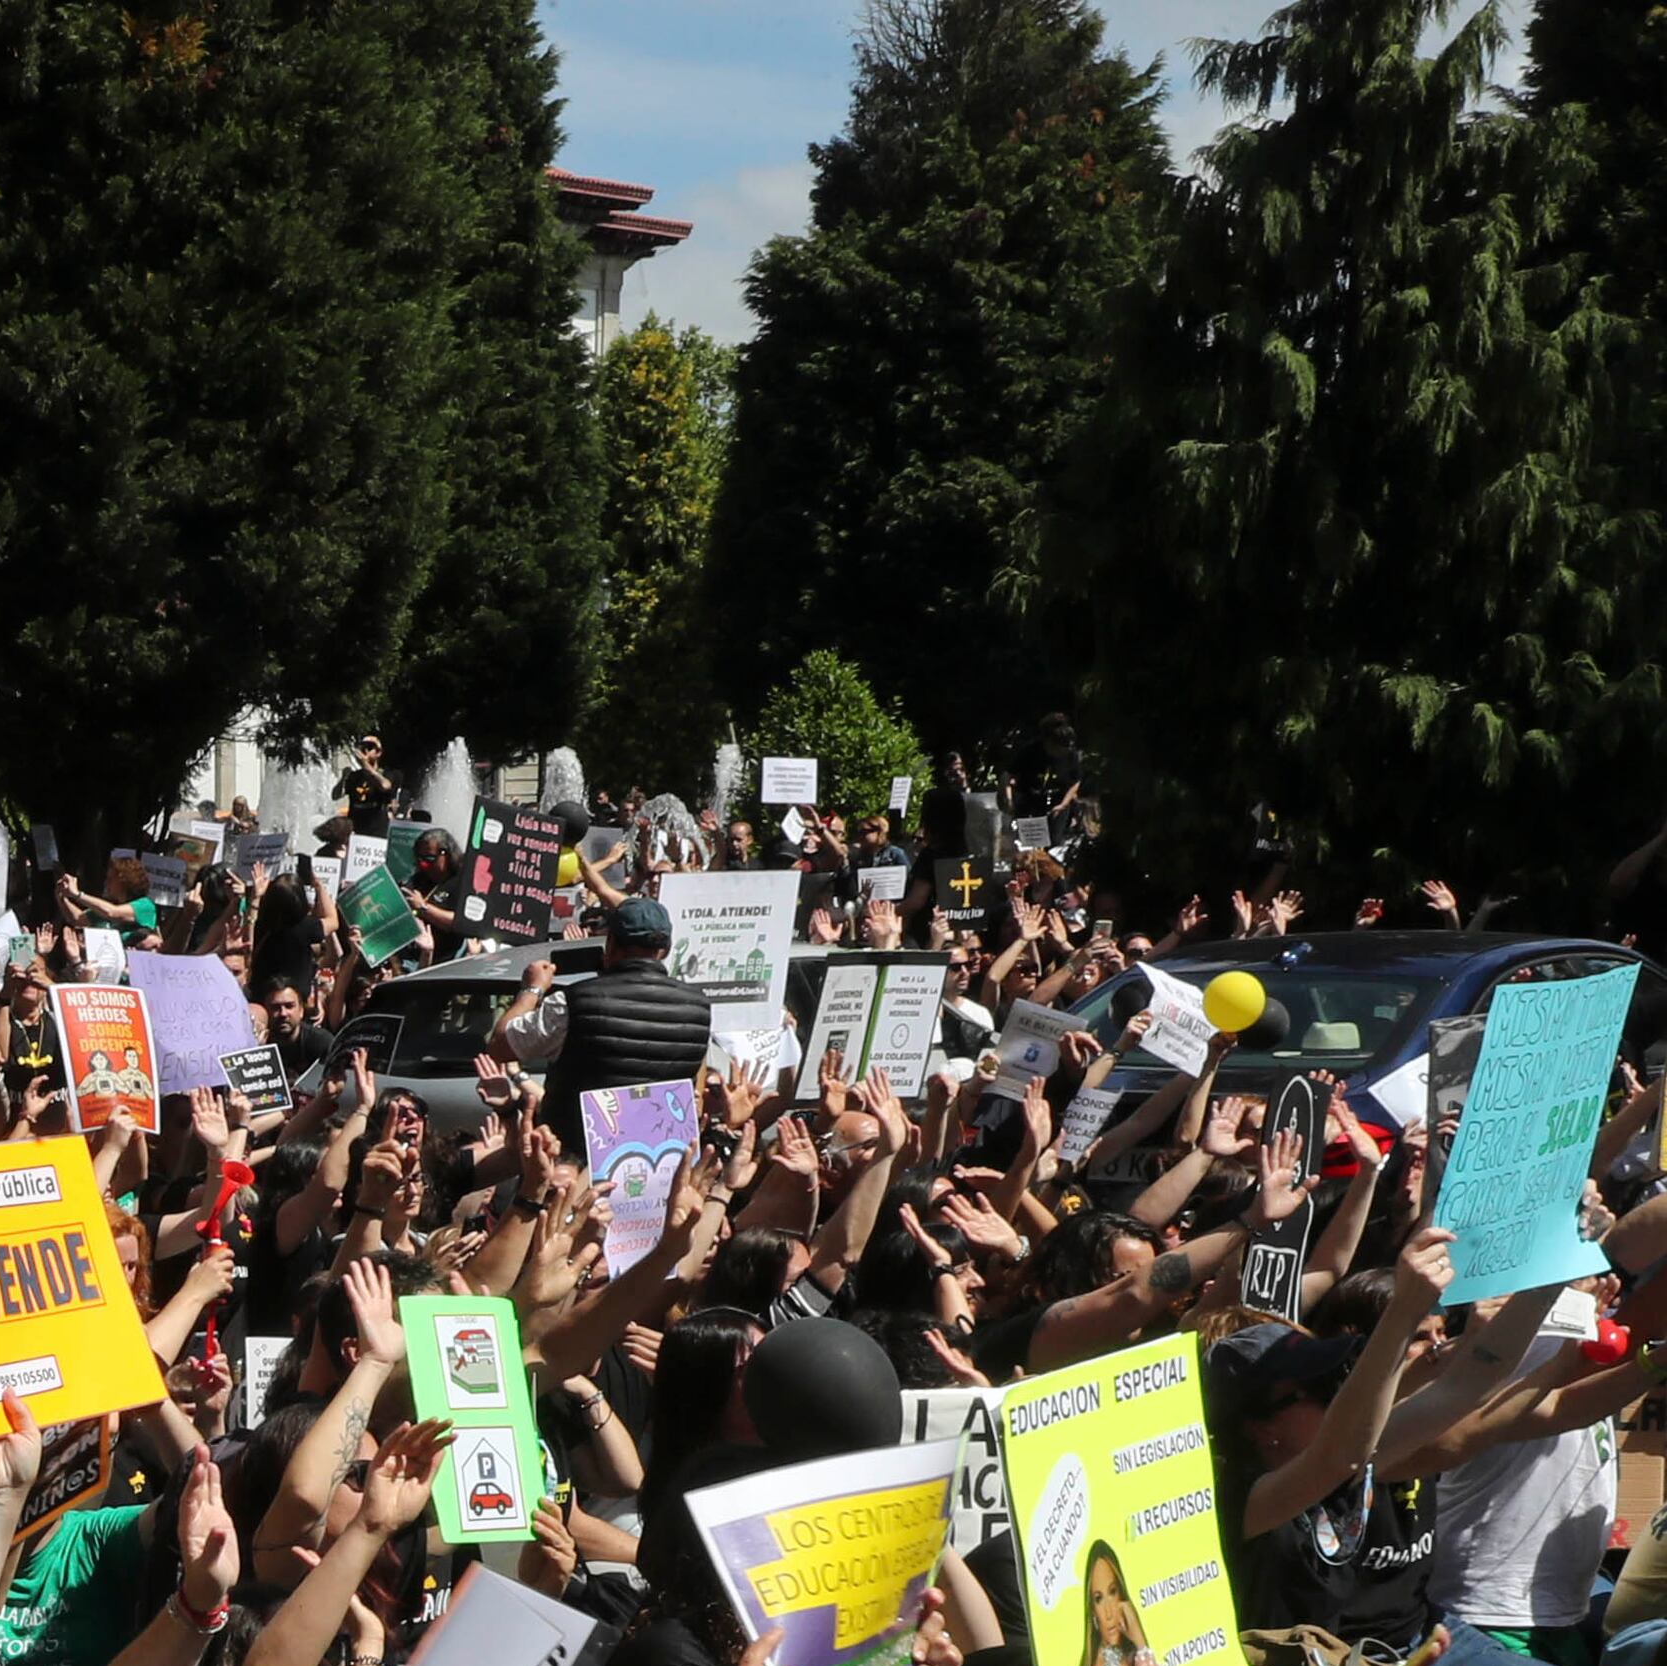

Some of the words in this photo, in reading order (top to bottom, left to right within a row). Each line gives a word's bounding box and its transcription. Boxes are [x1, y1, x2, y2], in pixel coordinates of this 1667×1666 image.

[719, 904, 772, 917] ATIENDE!
[65, 991, 89, 1007] NO
[91, 992, 137, 1009] SOMOS
[77, 1005, 133, 1025] HÉROES,
[87, 1023, 134, 1038] SOMOS
[1250, 1251, 1286, 1301] RIP
[1008, 1381, 1102, 1438] EDUCACION
[1114, 1354, 1188, 1403] ESPECIAL
[1113, 1451, 1133, 1476] SIN
[1132, 1422, 1206, 1470] LEGISLACIÓN
[1050, 1489, 1088, 1573] CUANDO?
[1144, 1487, 1213, 1533] RECURSOS
[775, 1514, 831, 1554] LOS
[1036, 1543, 1051, 1565] EL
[754, 1554, 888, 1607] EDUCACIÓN
[1139, 1584, 1159, 1609] SIN
[1157, 1559, 1220, 1602] VISIBILIDAD
[1182, 1626, 1227, 1663] APOYOS
